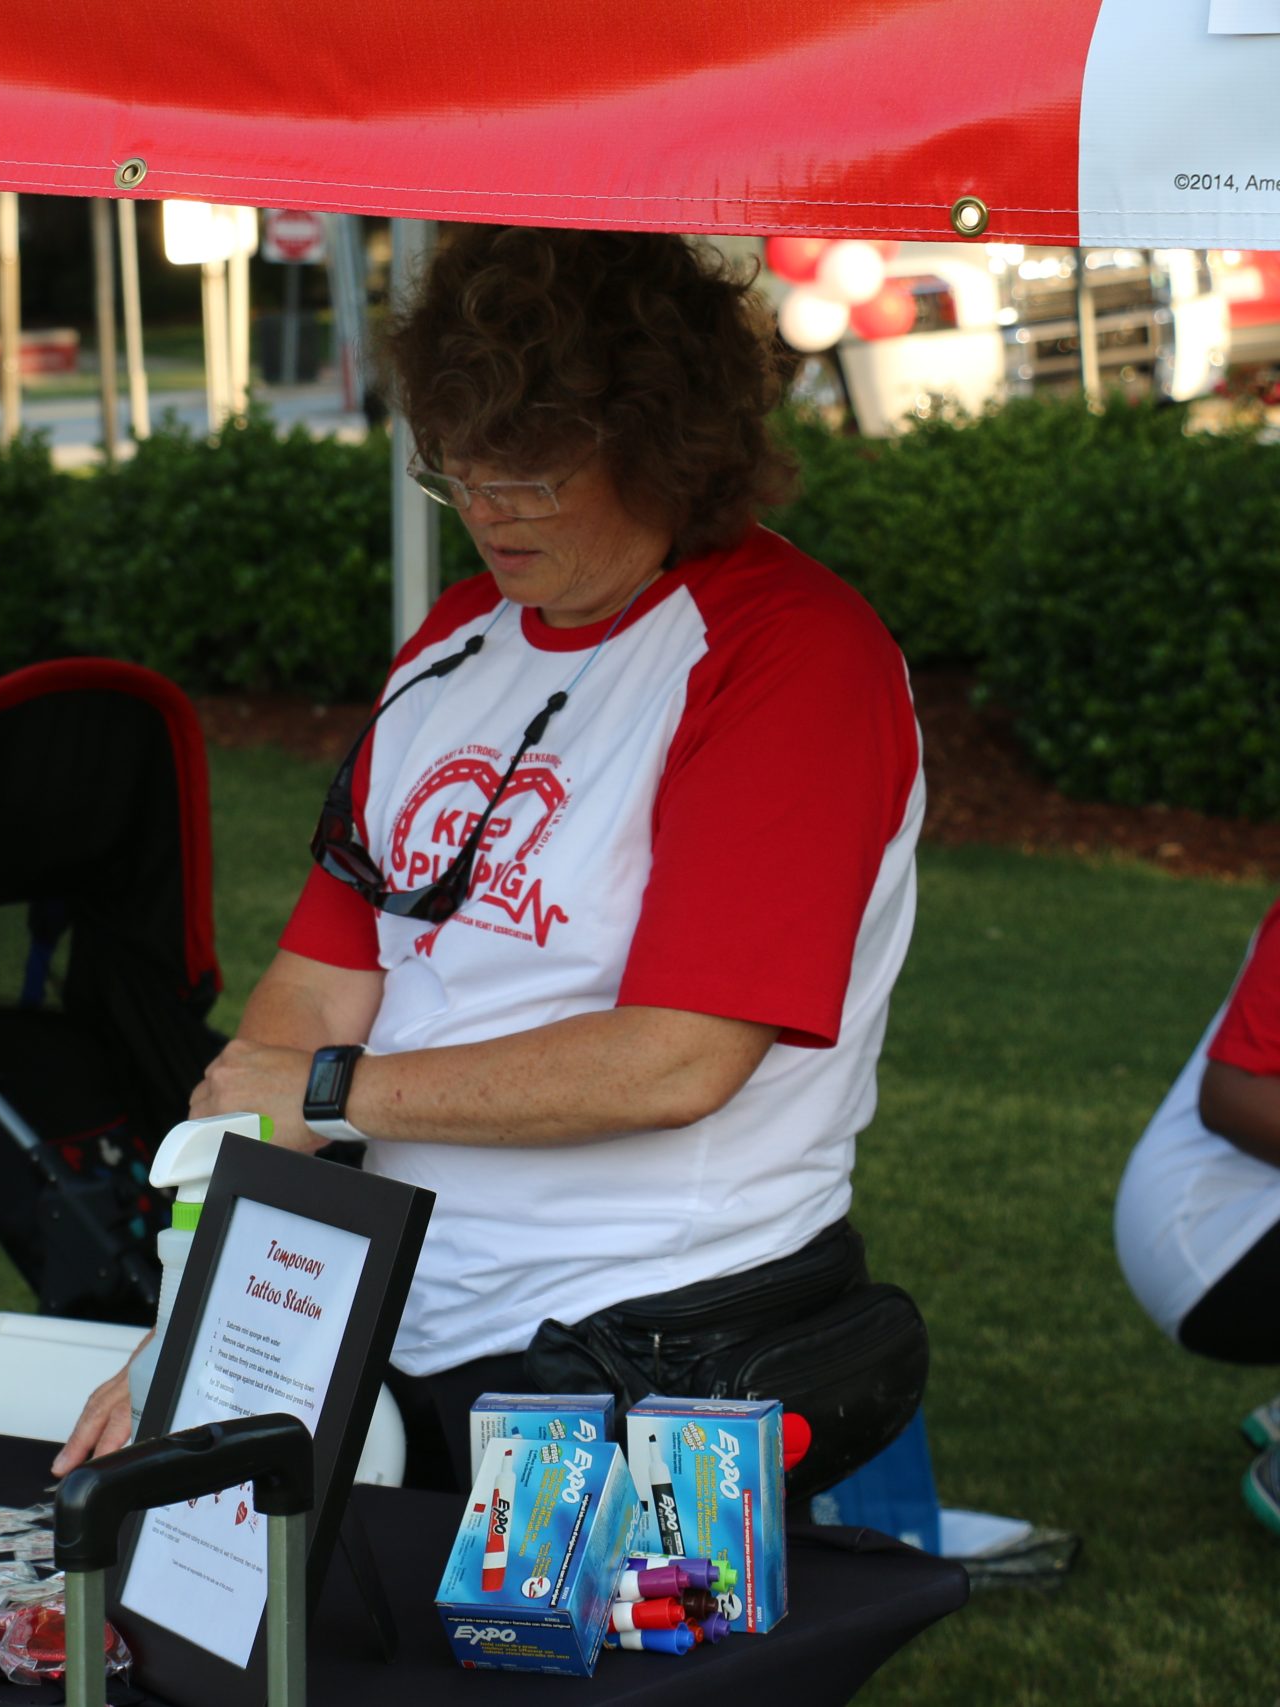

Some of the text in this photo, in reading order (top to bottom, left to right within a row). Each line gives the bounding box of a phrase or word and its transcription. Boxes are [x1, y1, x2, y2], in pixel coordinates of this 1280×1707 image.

[1173, 173, 1239, 193] ©2014,
[266, 1239, 325, 1280] Temporary
[245, 1275, 322, 1320] Tattoo Station
[682, 1427, 696, 1451] colors
[688, 1421, 705, 1450] intense
[562, 1448, 593, 1504] EXPO
[710, 1428, 740, 1500] EXPO
[493, 1498, 510, 1534] EXPO
[658, 1494, 679, 1531] EXPO
[454, 1626, 516, 1645] EXPO
